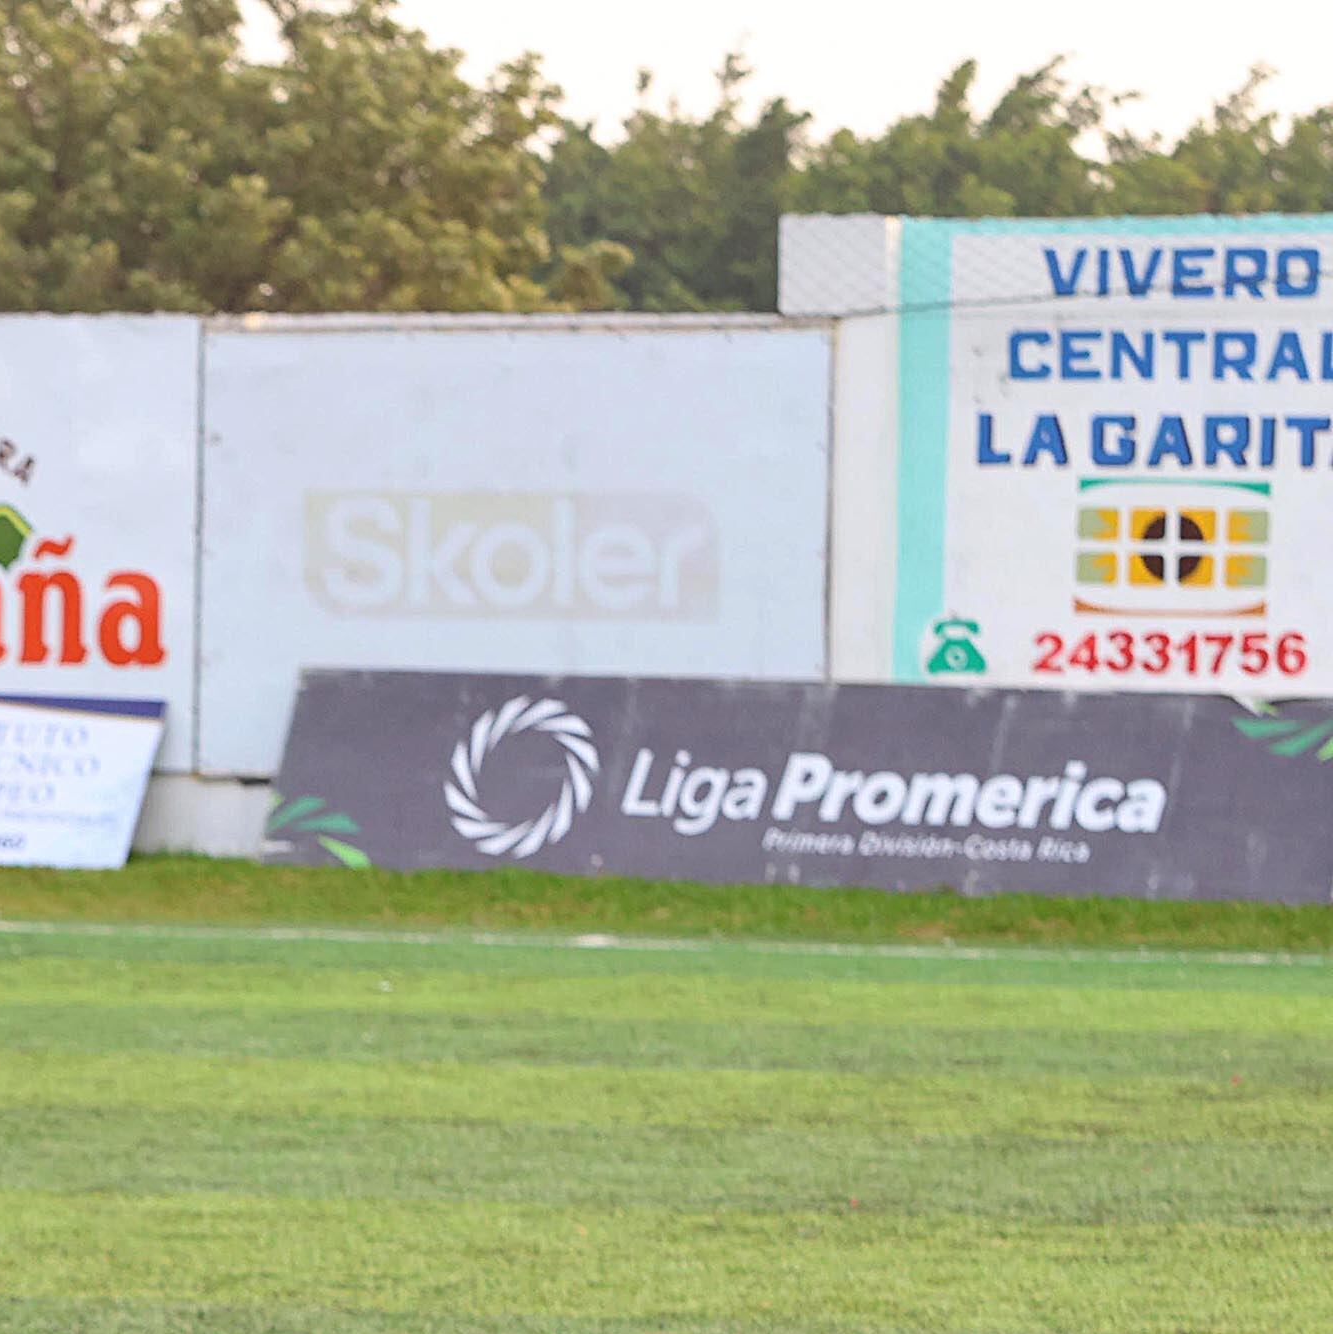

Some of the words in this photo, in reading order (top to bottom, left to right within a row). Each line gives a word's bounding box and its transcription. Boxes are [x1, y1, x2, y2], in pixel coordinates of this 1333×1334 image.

[1043, 248, 1320, 297] VIVERO
[977, 413, 1068, 466] LA
[1090, 414, 1333, 468] GARIT
[324, 497, 707, 608] Skoler
[1033, 632, 1308, 677] 24331756
[621, 747, 767, 835] Liga
[771, 751, 1168, 833] Promerica
